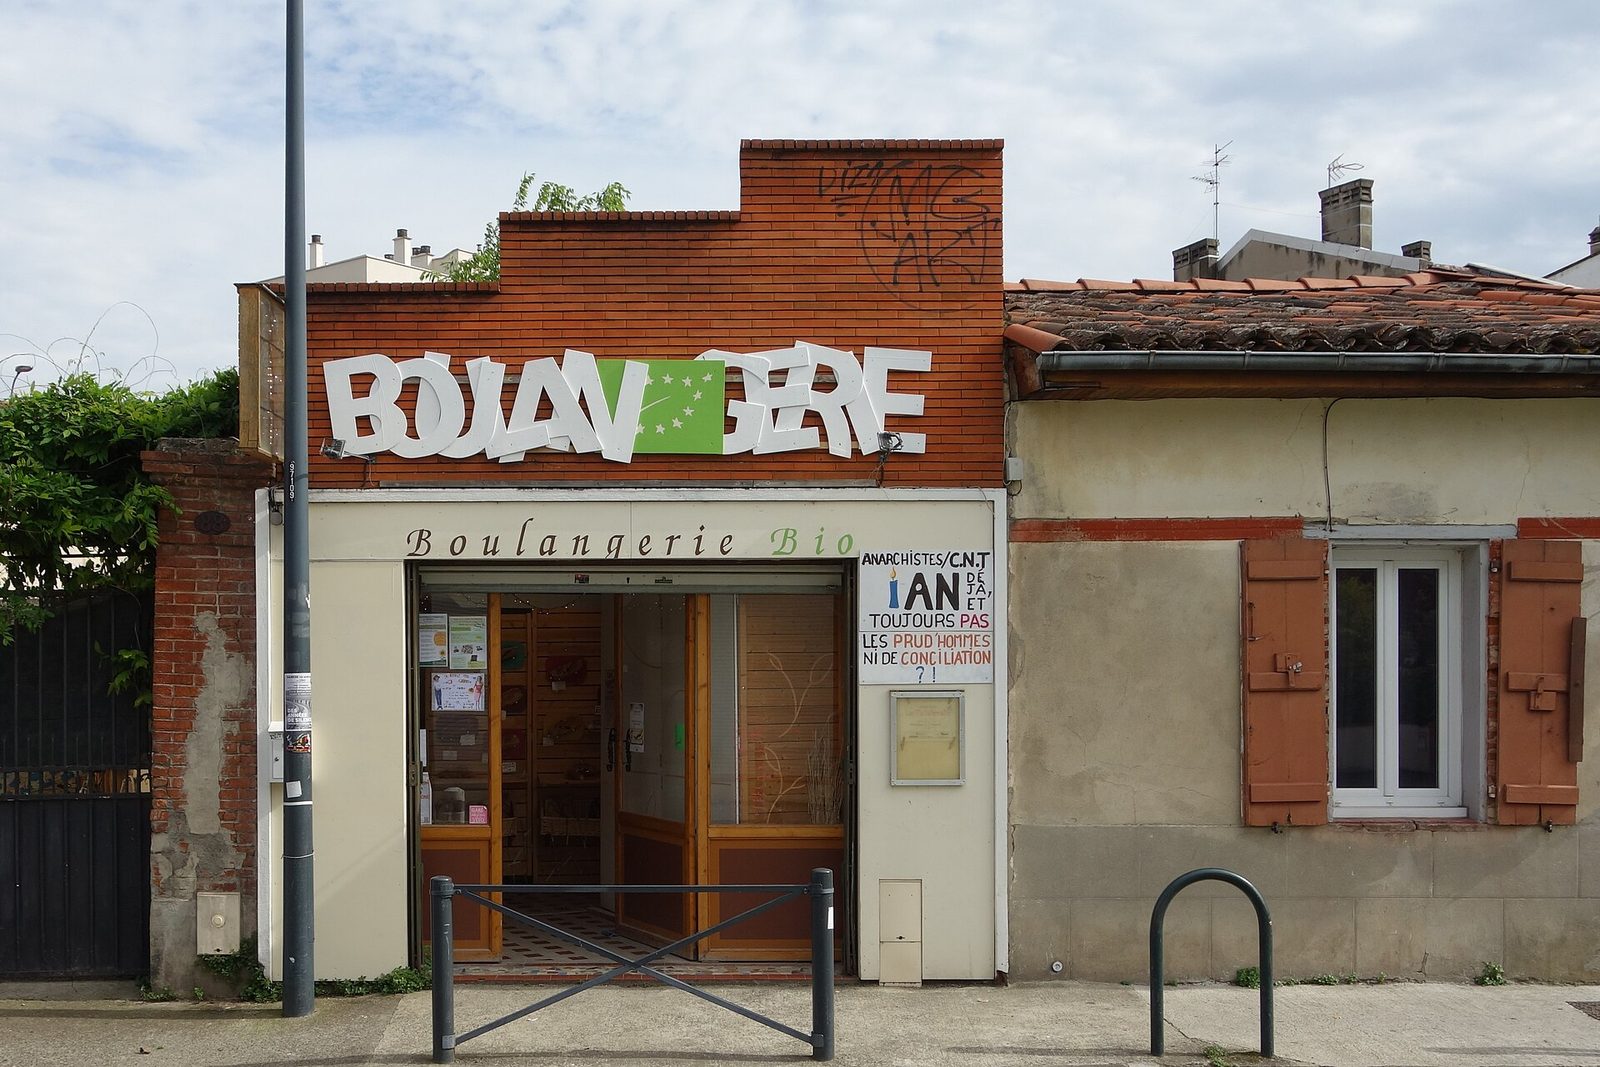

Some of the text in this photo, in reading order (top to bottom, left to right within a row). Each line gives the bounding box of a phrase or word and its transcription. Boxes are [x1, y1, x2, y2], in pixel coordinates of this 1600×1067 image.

[406, 517, 854, 559] Boulangerie Bio
[903, 572, 960, 611] AN
[967, 597, 986, 610] ET
[868, 613, 990, 629] TOUJOURS PAS
[862, 633, 888, 648] LES
[882, 652, 898, 665] DE
